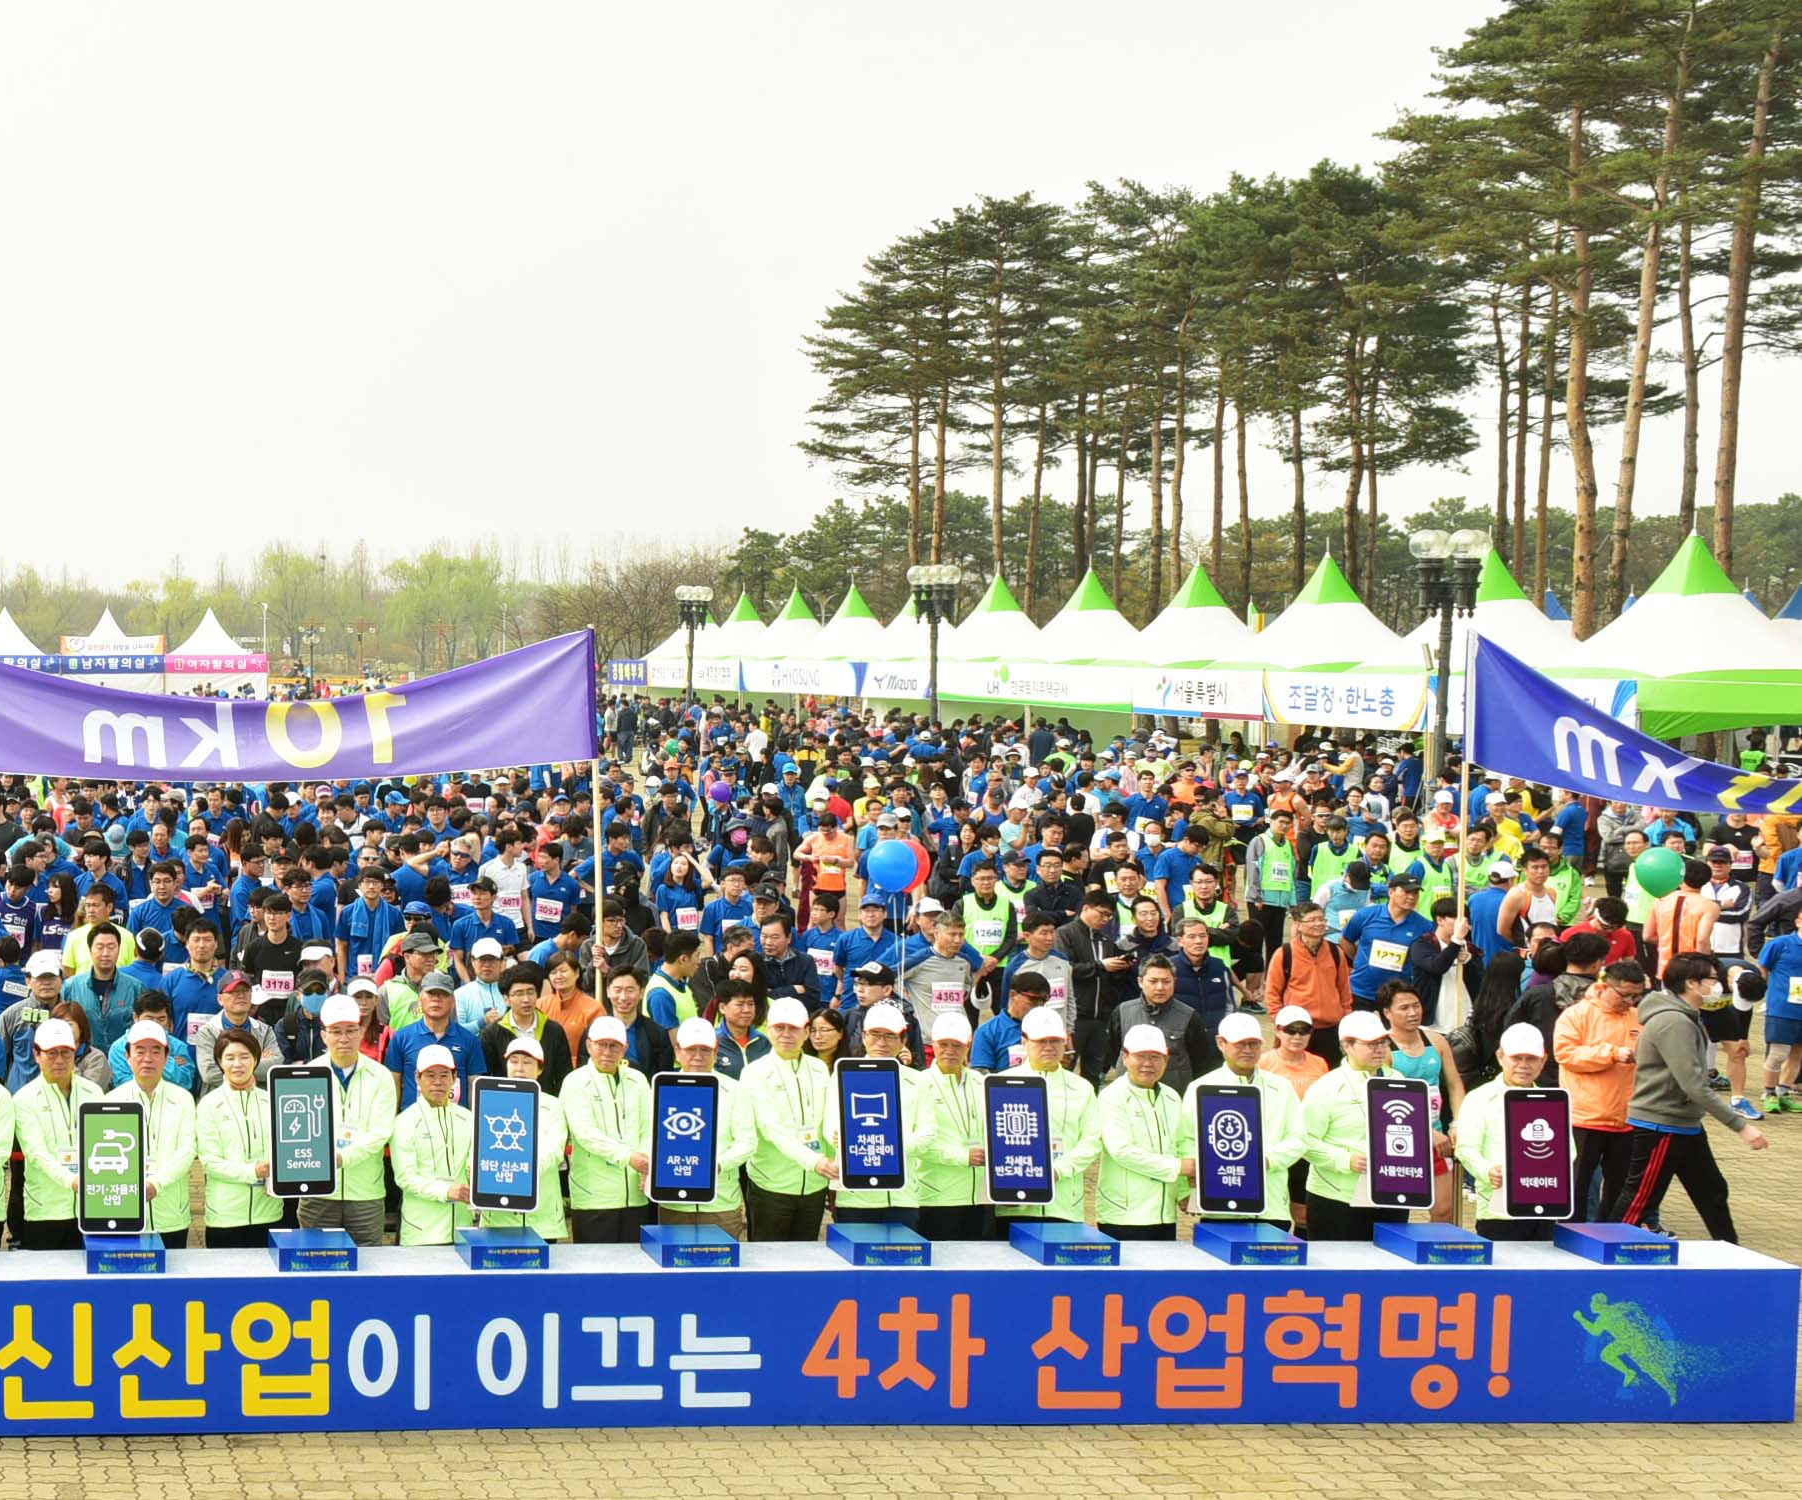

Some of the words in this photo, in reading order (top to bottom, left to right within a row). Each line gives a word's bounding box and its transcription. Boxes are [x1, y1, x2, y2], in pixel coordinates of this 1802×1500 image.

[82, 657, 145, 670] 남자탈의실
[187, 658, 246, 670] 여자탈의실
[782, 667, 821, 687] HYOSUNG
[987, 681, 999, 694] LH
[1173, 679, 1228, 705] 서울특별시
[264, 979, 290, 990] 3178
[936, 991, 960, 1002] 4363
[857, 1134, 885, 1146] 차세대
[294, 1148, 313, 1159] ESS
[849, 1145, 894, 1156] 디스플레이
[286, 1159, 322, 1170] Service
[480, 1160, 499, 1172] 첨단
[501, 1161, 529, 1173] 신소재
[863, 1155, 881, 1167] 산업
[1004, 1155, 1032, 1167] 차세대
[673, 1165, 692, 1177] 산업
[995, 1166, 1022, 1177] 반도체
[1024, 1166, 1043, 1178] 산업
[1217, 1165, 1246, 1176] 스마트
[1379, 1165, 1423, 1178] 사물인터넷
[495, 1172, 514, 1183] 산업
[1222, 1175, 1242, 1187] 미터
[1520, 1177, 1558, 1189] 빅데이터
[103, 1195, 122, 1206] 산업
[475, 1312, 762, 1408] 이끄는
[800, 1293, 986, 1409] 4차
